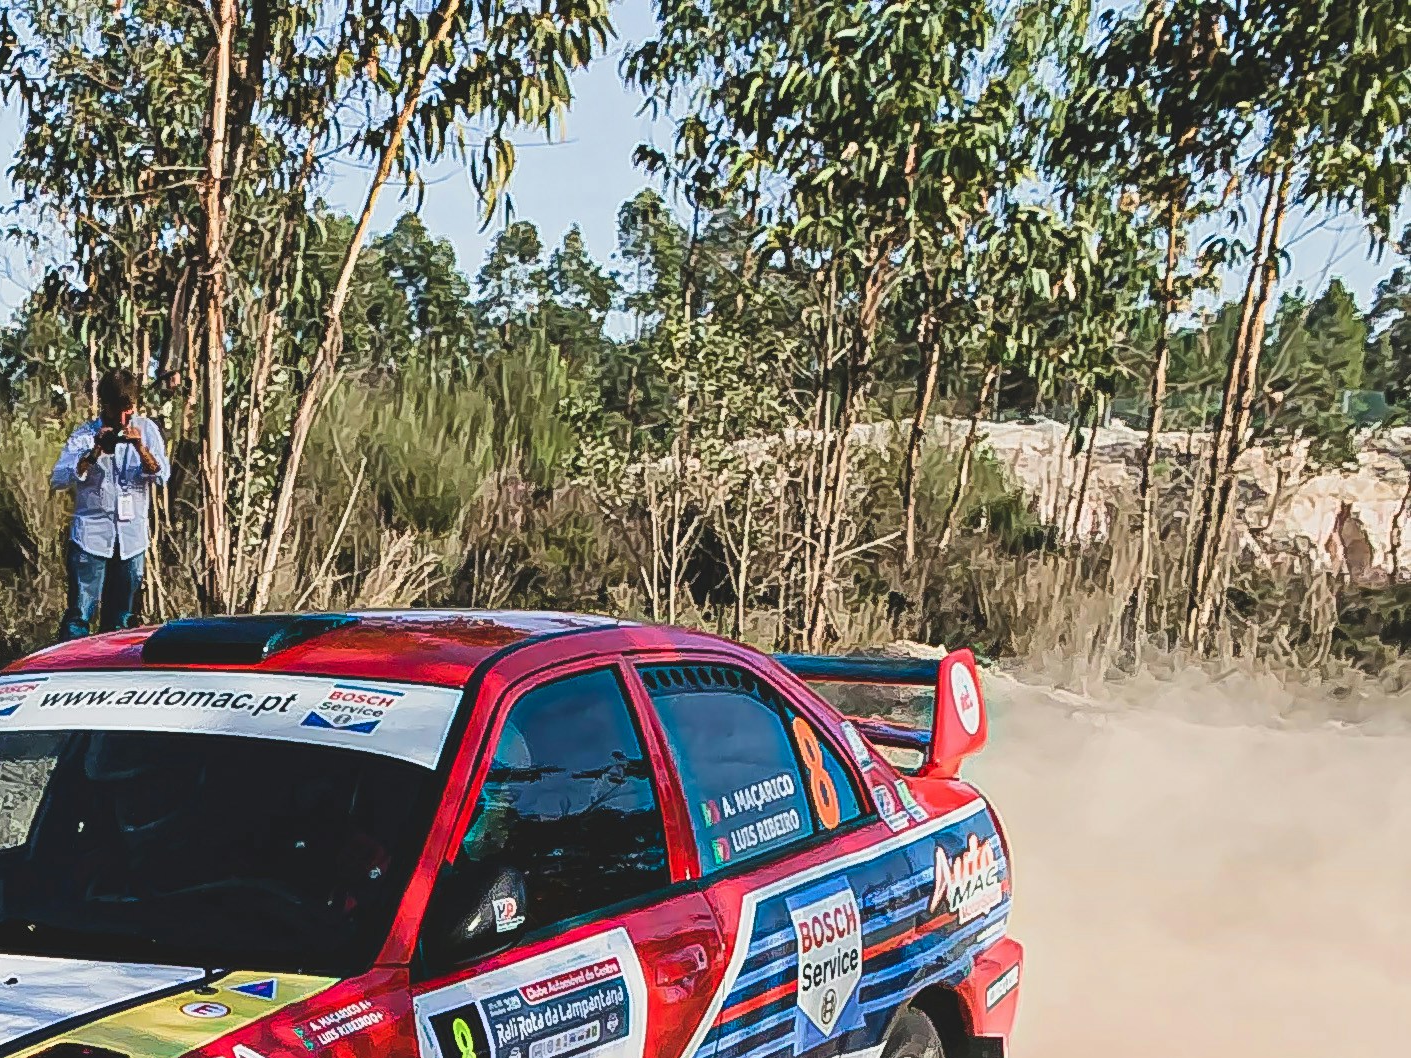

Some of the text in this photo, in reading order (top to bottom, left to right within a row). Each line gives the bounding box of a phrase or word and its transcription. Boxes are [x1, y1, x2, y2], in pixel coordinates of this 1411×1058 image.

[39, 687, 297, 715] www.automac.pt
[318, 701, 384, 717] Service
[328, 691, 395, 708] BOSCH
[792, 716, 839, 829] 8
[721, 774, 794, 818] A. MAÇARICO
[731, 808, 800, 852] LUIS RIBEIRO
[798, 903, 857, 953] BOSCH
[801, 947, 859, 991] Service
[516, 1010, 544, 1041] Rota
